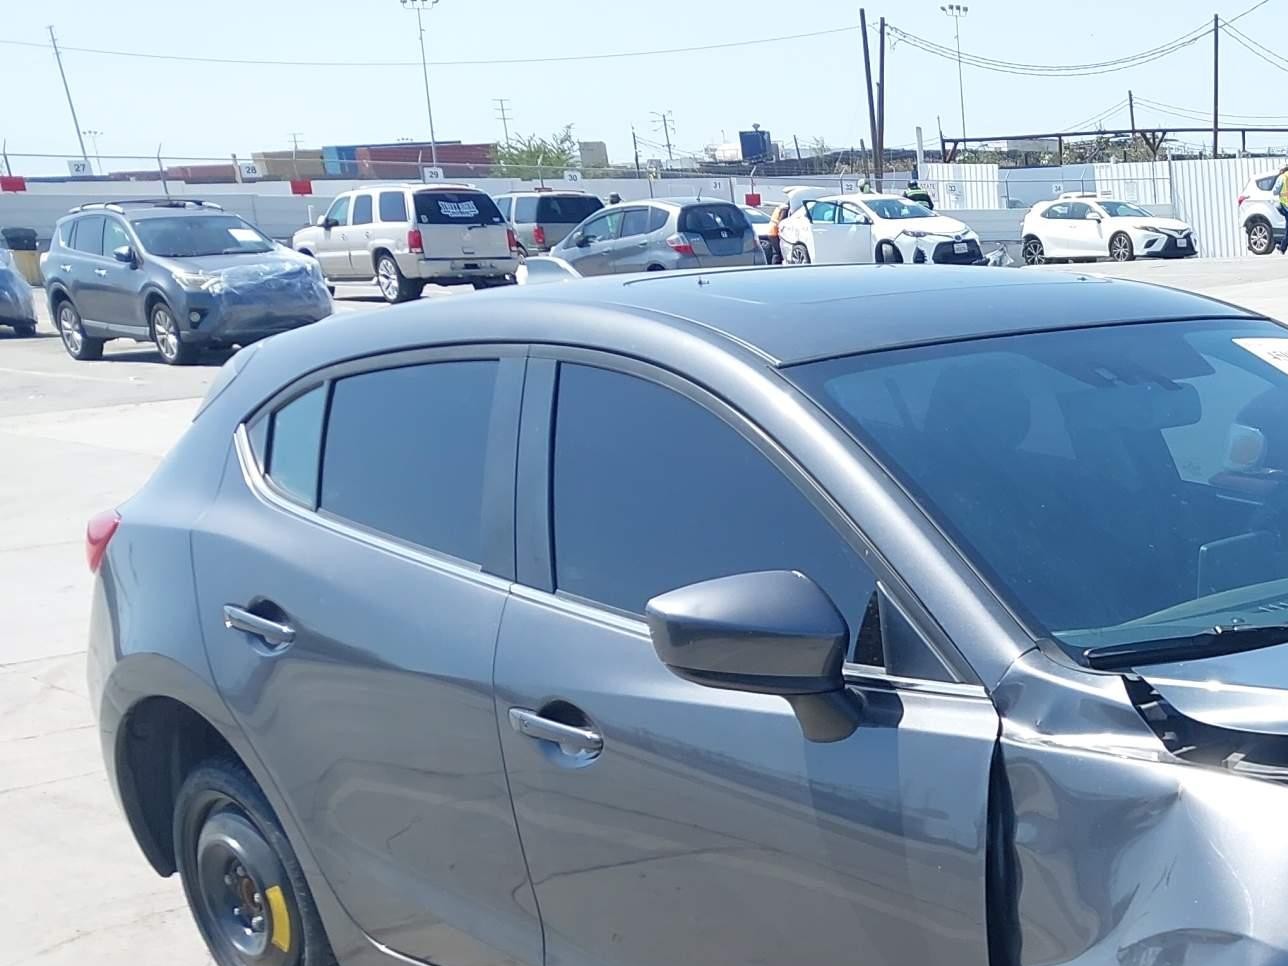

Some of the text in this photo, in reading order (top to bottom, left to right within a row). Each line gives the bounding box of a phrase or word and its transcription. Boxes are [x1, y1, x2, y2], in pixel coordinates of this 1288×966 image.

[74, 164, 86, 173] 27
[245, 166, 257, 174] 28
[429, 171, 439, 179] 29
[568, 175, 578, 183] 30
